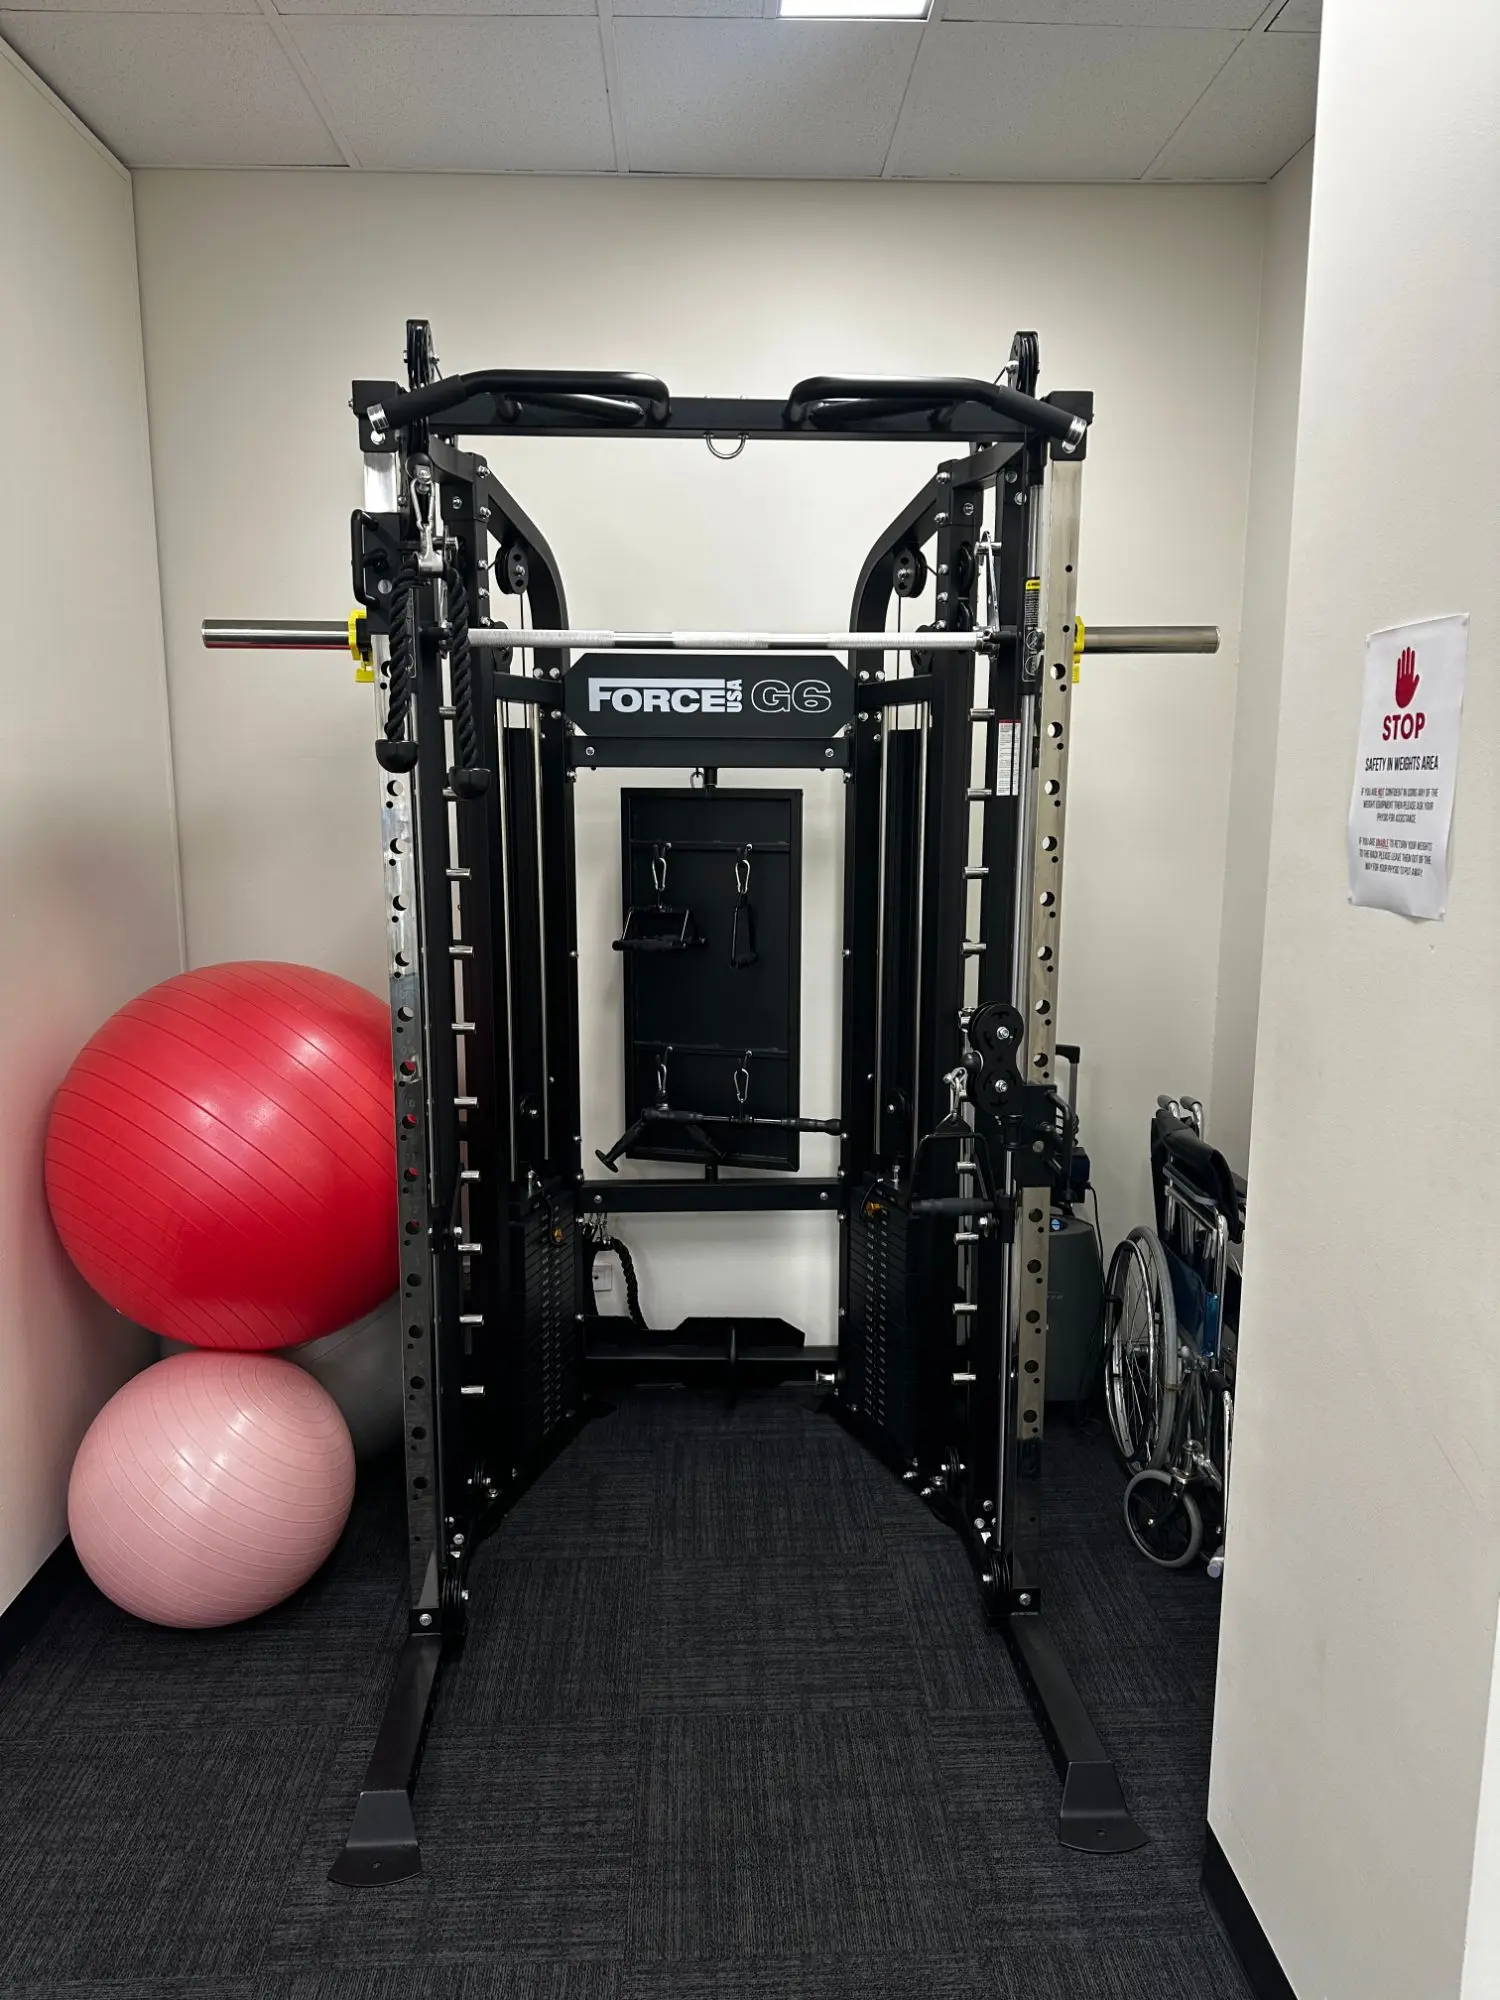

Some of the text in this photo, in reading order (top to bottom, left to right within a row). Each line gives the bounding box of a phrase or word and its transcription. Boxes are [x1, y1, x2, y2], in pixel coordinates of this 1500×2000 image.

[588, 677, 832, 713] FORCE USA G6
[1382, 712, 1426, 741] STOP
[1365, 755, 1439, 771] SAFETY IN WEIGHTS AREA
